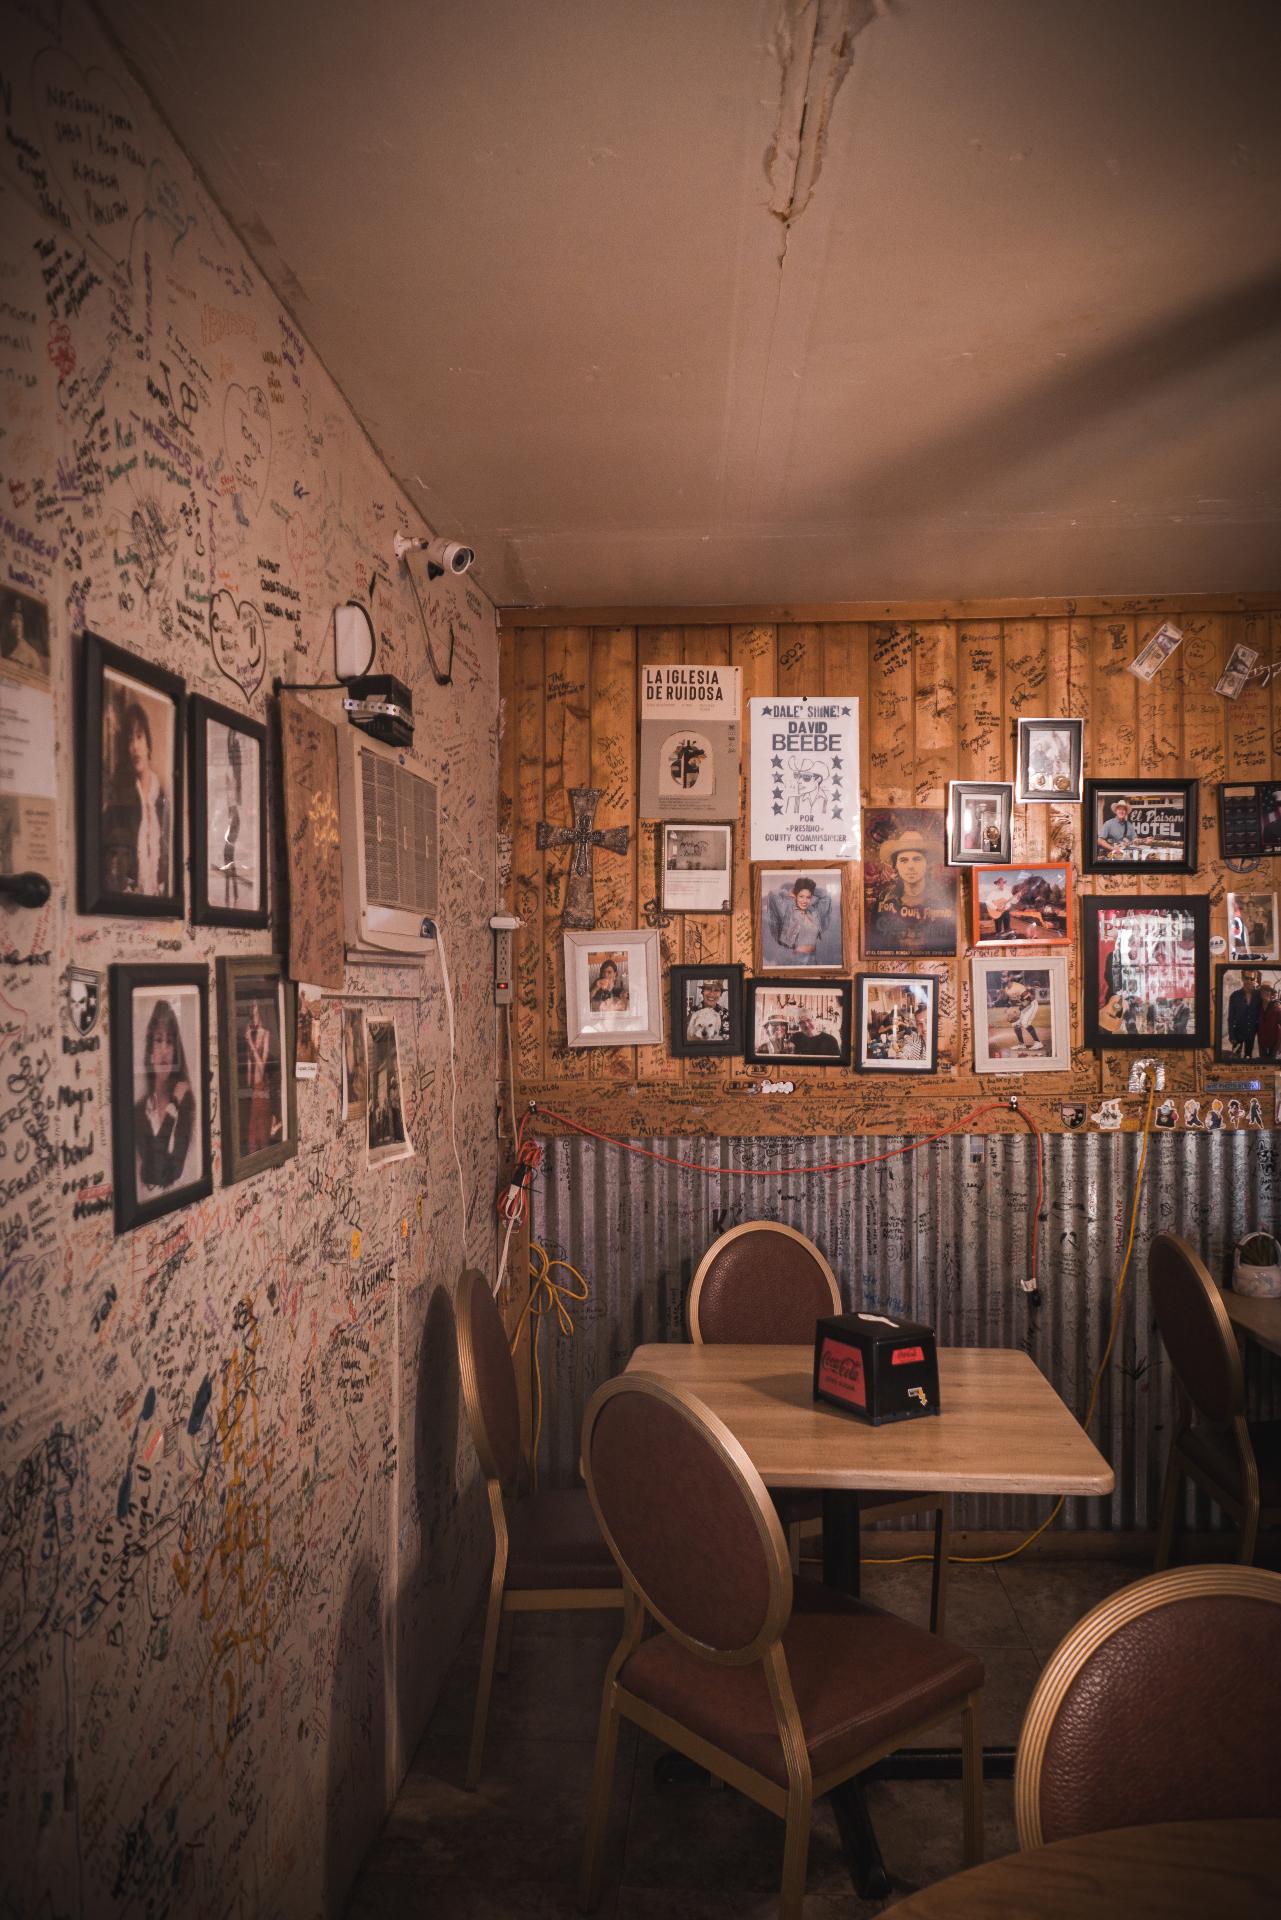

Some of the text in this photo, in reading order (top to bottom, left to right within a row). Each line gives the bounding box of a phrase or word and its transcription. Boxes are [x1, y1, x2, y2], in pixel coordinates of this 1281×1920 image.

[646, 669, 720, 685] LA IGLESIA
[646, 686, 725, 701] DE RUIDOSA
[788, 721, 828, 734] DAVID
[771, 734, 842, 752] BEEBE
[799, 815, 815, 823] POR
[1130, 810, 1143, 822] El
[1133, 821, 1181, 837] HOTEL
[765, 834, 792, 842] COUNTY
[786, 844, 824, 853] PRECINCT 4
[878, 902, 898, 914] FOR
[901, 906, 921, 920] OUR
